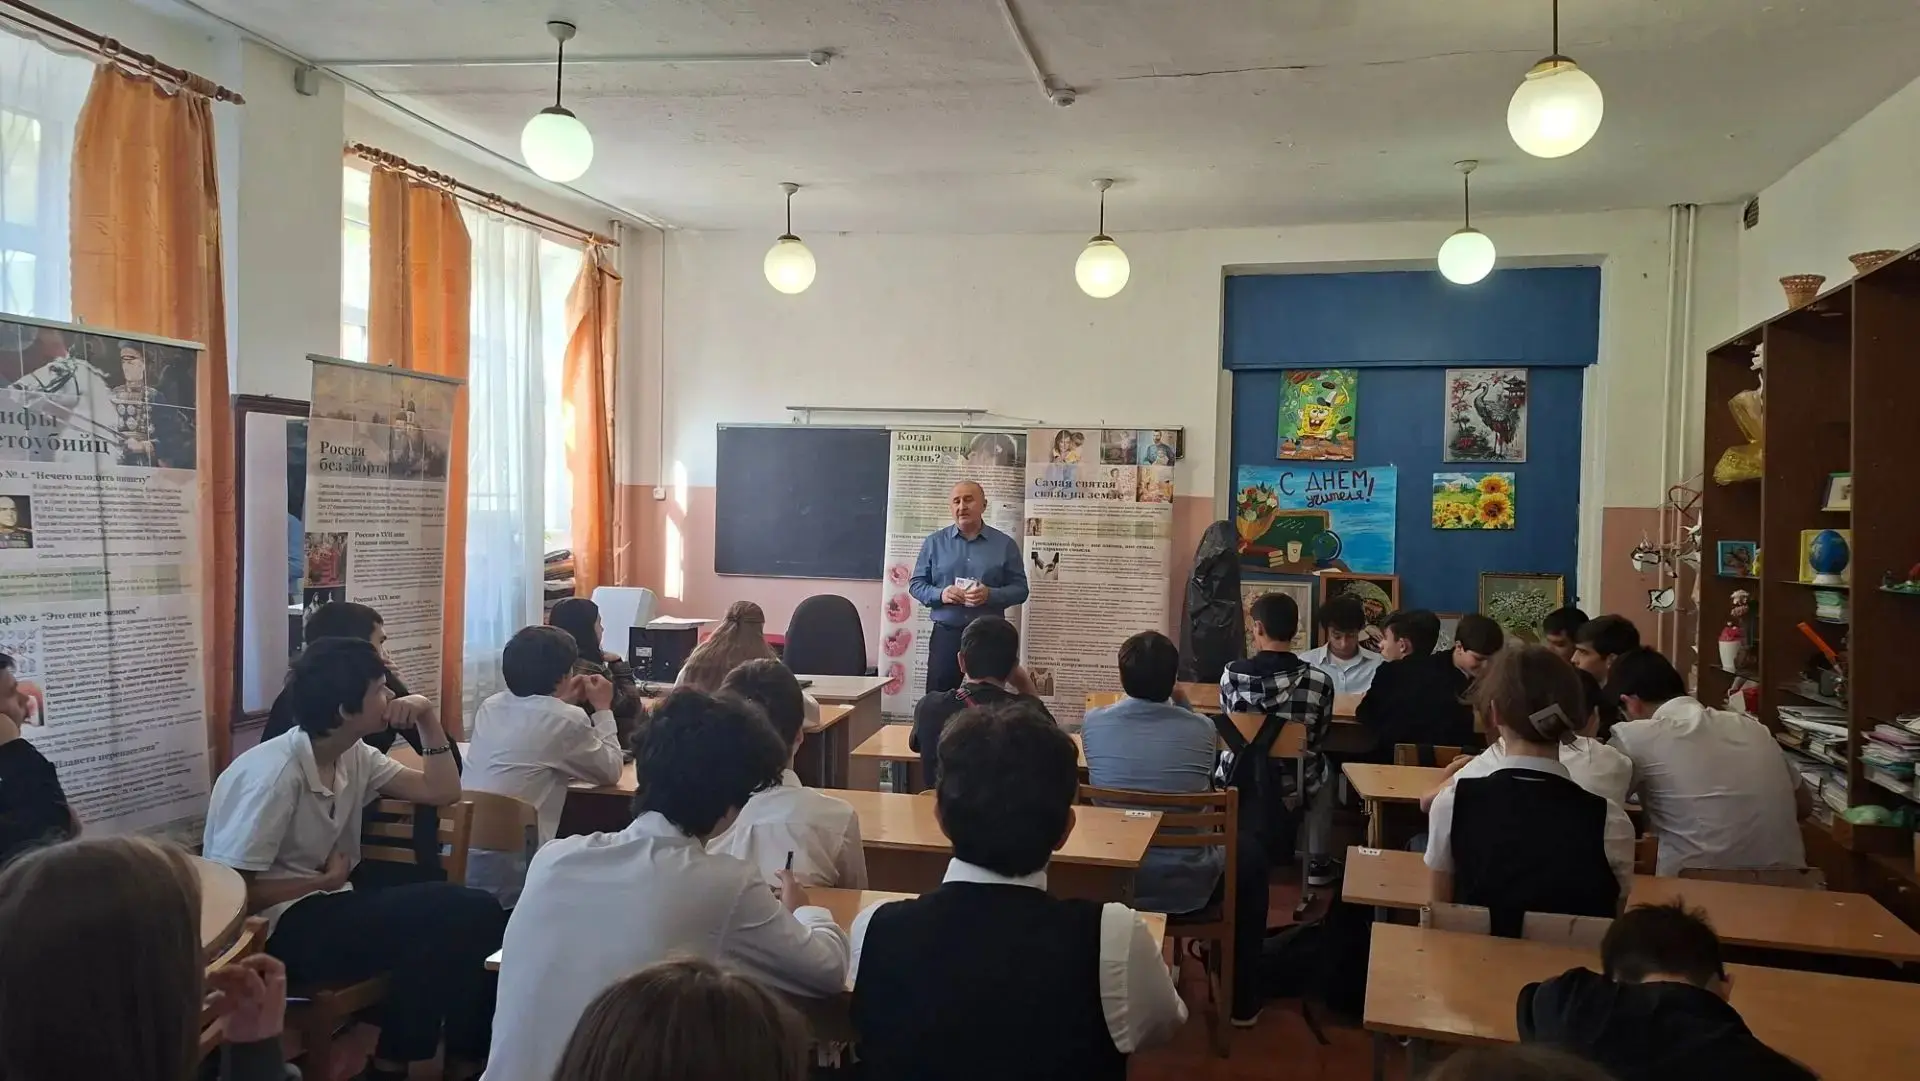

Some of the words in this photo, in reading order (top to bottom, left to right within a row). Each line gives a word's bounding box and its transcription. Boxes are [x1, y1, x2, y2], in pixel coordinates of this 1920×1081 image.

[898, 431, 932, 442] Когда
[320, 441, 365, 456] Россия
[897, 443, 966, 453] начинается
[896, 453, 940, 463] жизнь?
[319, 457, 342, 472] без
[346, 460, 388, 476] аборта
[1034, 477, 1072, 488] Самая
[1075, 480, 1116, 489] святая
[1280, 471, 1295, 496] С
[1034, 490, 1068, 498] связь
[1070, 491, 1085, 499] на
[1087, 491, 1125, 500] земле
